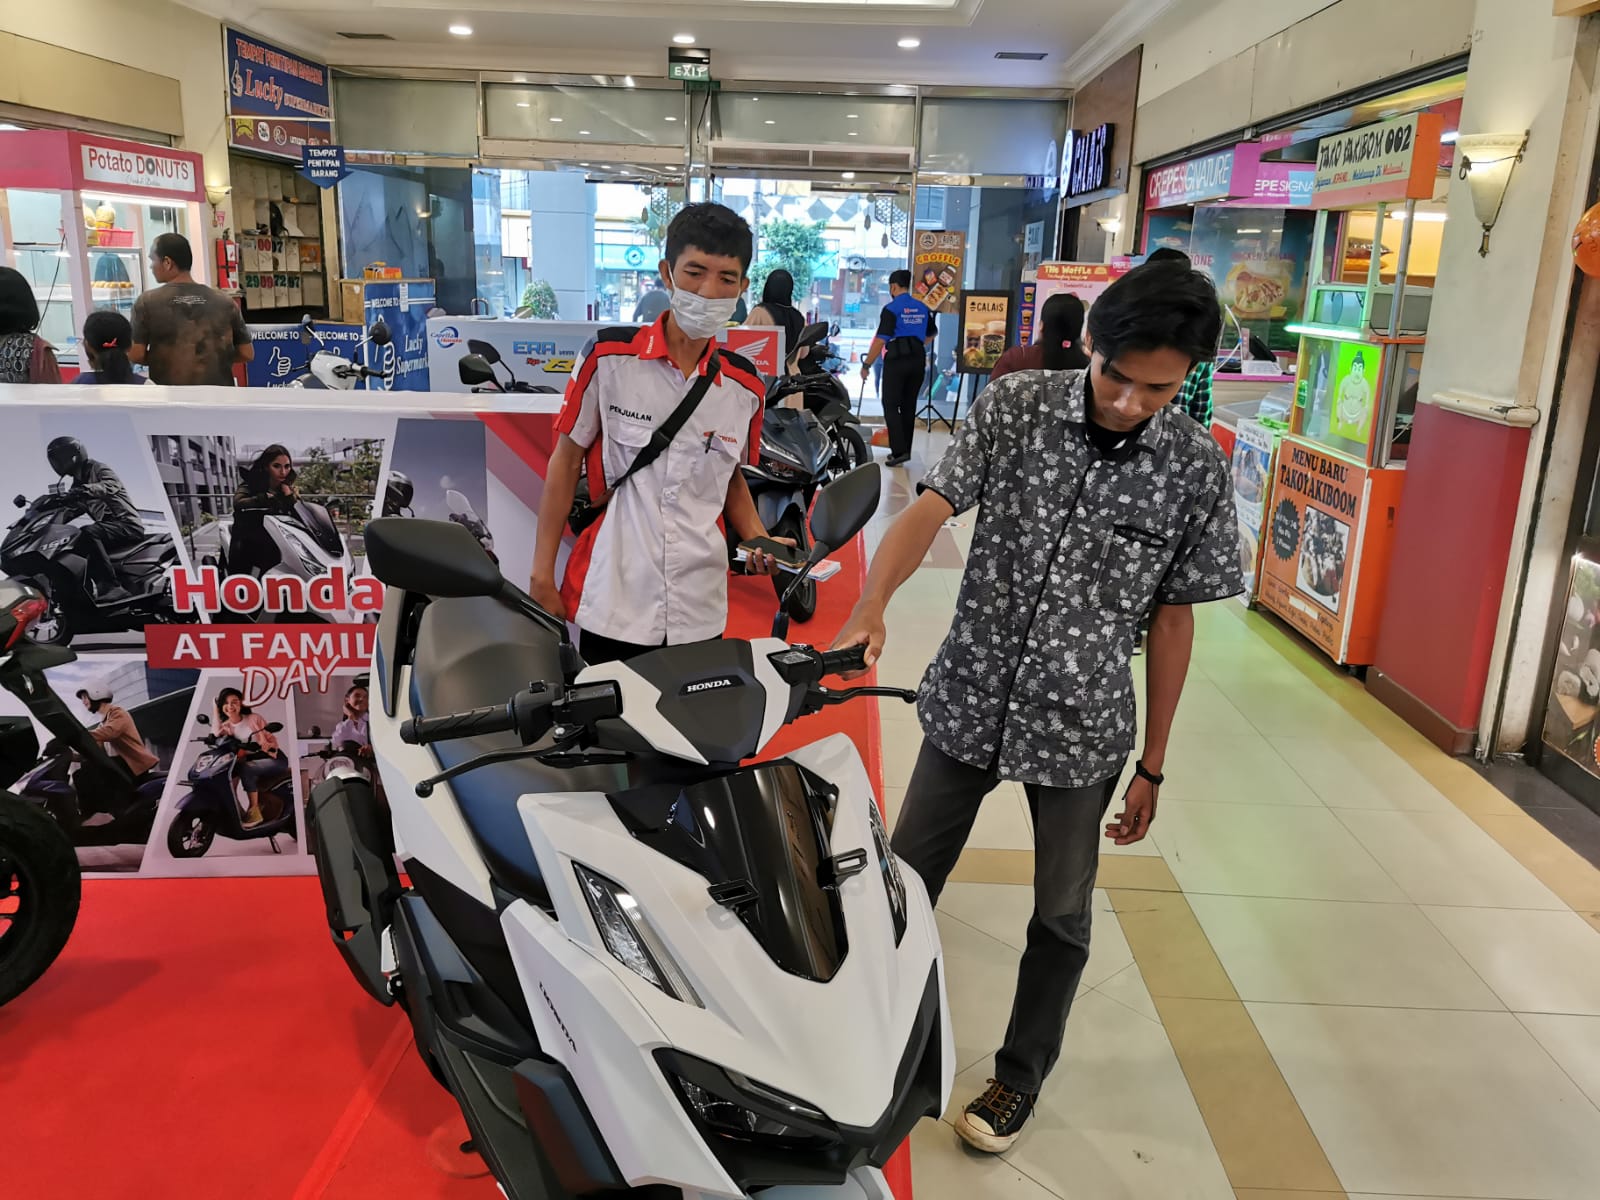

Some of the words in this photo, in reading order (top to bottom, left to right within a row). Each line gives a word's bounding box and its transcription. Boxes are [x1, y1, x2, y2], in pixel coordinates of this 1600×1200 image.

[674, 65, 708, 77] EXIT
[245, 68, 284, 111] Lucky
[308, 149, 336, 157] TEMPAT
[1318, 140, 1342, 172] TAKO
[1385, 124, 1412, 154] 002
[88, 148, 132, 172] Potato
[136, 156, 188, 180] DONUTS
[916, 252, 961, 267] CROFFLE
[372, 298, 392, 308] WELCOME
[977, 302, 1004, 312] CALAIS
[251, 331, 288, 340] WELCOME
[290, 331, 299, 340] TO
[349, 332, 359, 340] TO
[405, 334, 423, 354] Lucky
[513, 342, 555, 355] ERA
[1292, 448, 1319, 471] MENU
[1320, 458, 1348, 484] BARU
[1280, 464, 1356, 518] TAKOYAKIBOOM
[170, 564, 384, 614] Honda
[173, 632, 225, 660] AT
[242, 632, 372, 660] FAMIL
[240, 654, 342, 708] DAY
[687, 680, 732, 692] HONDA
